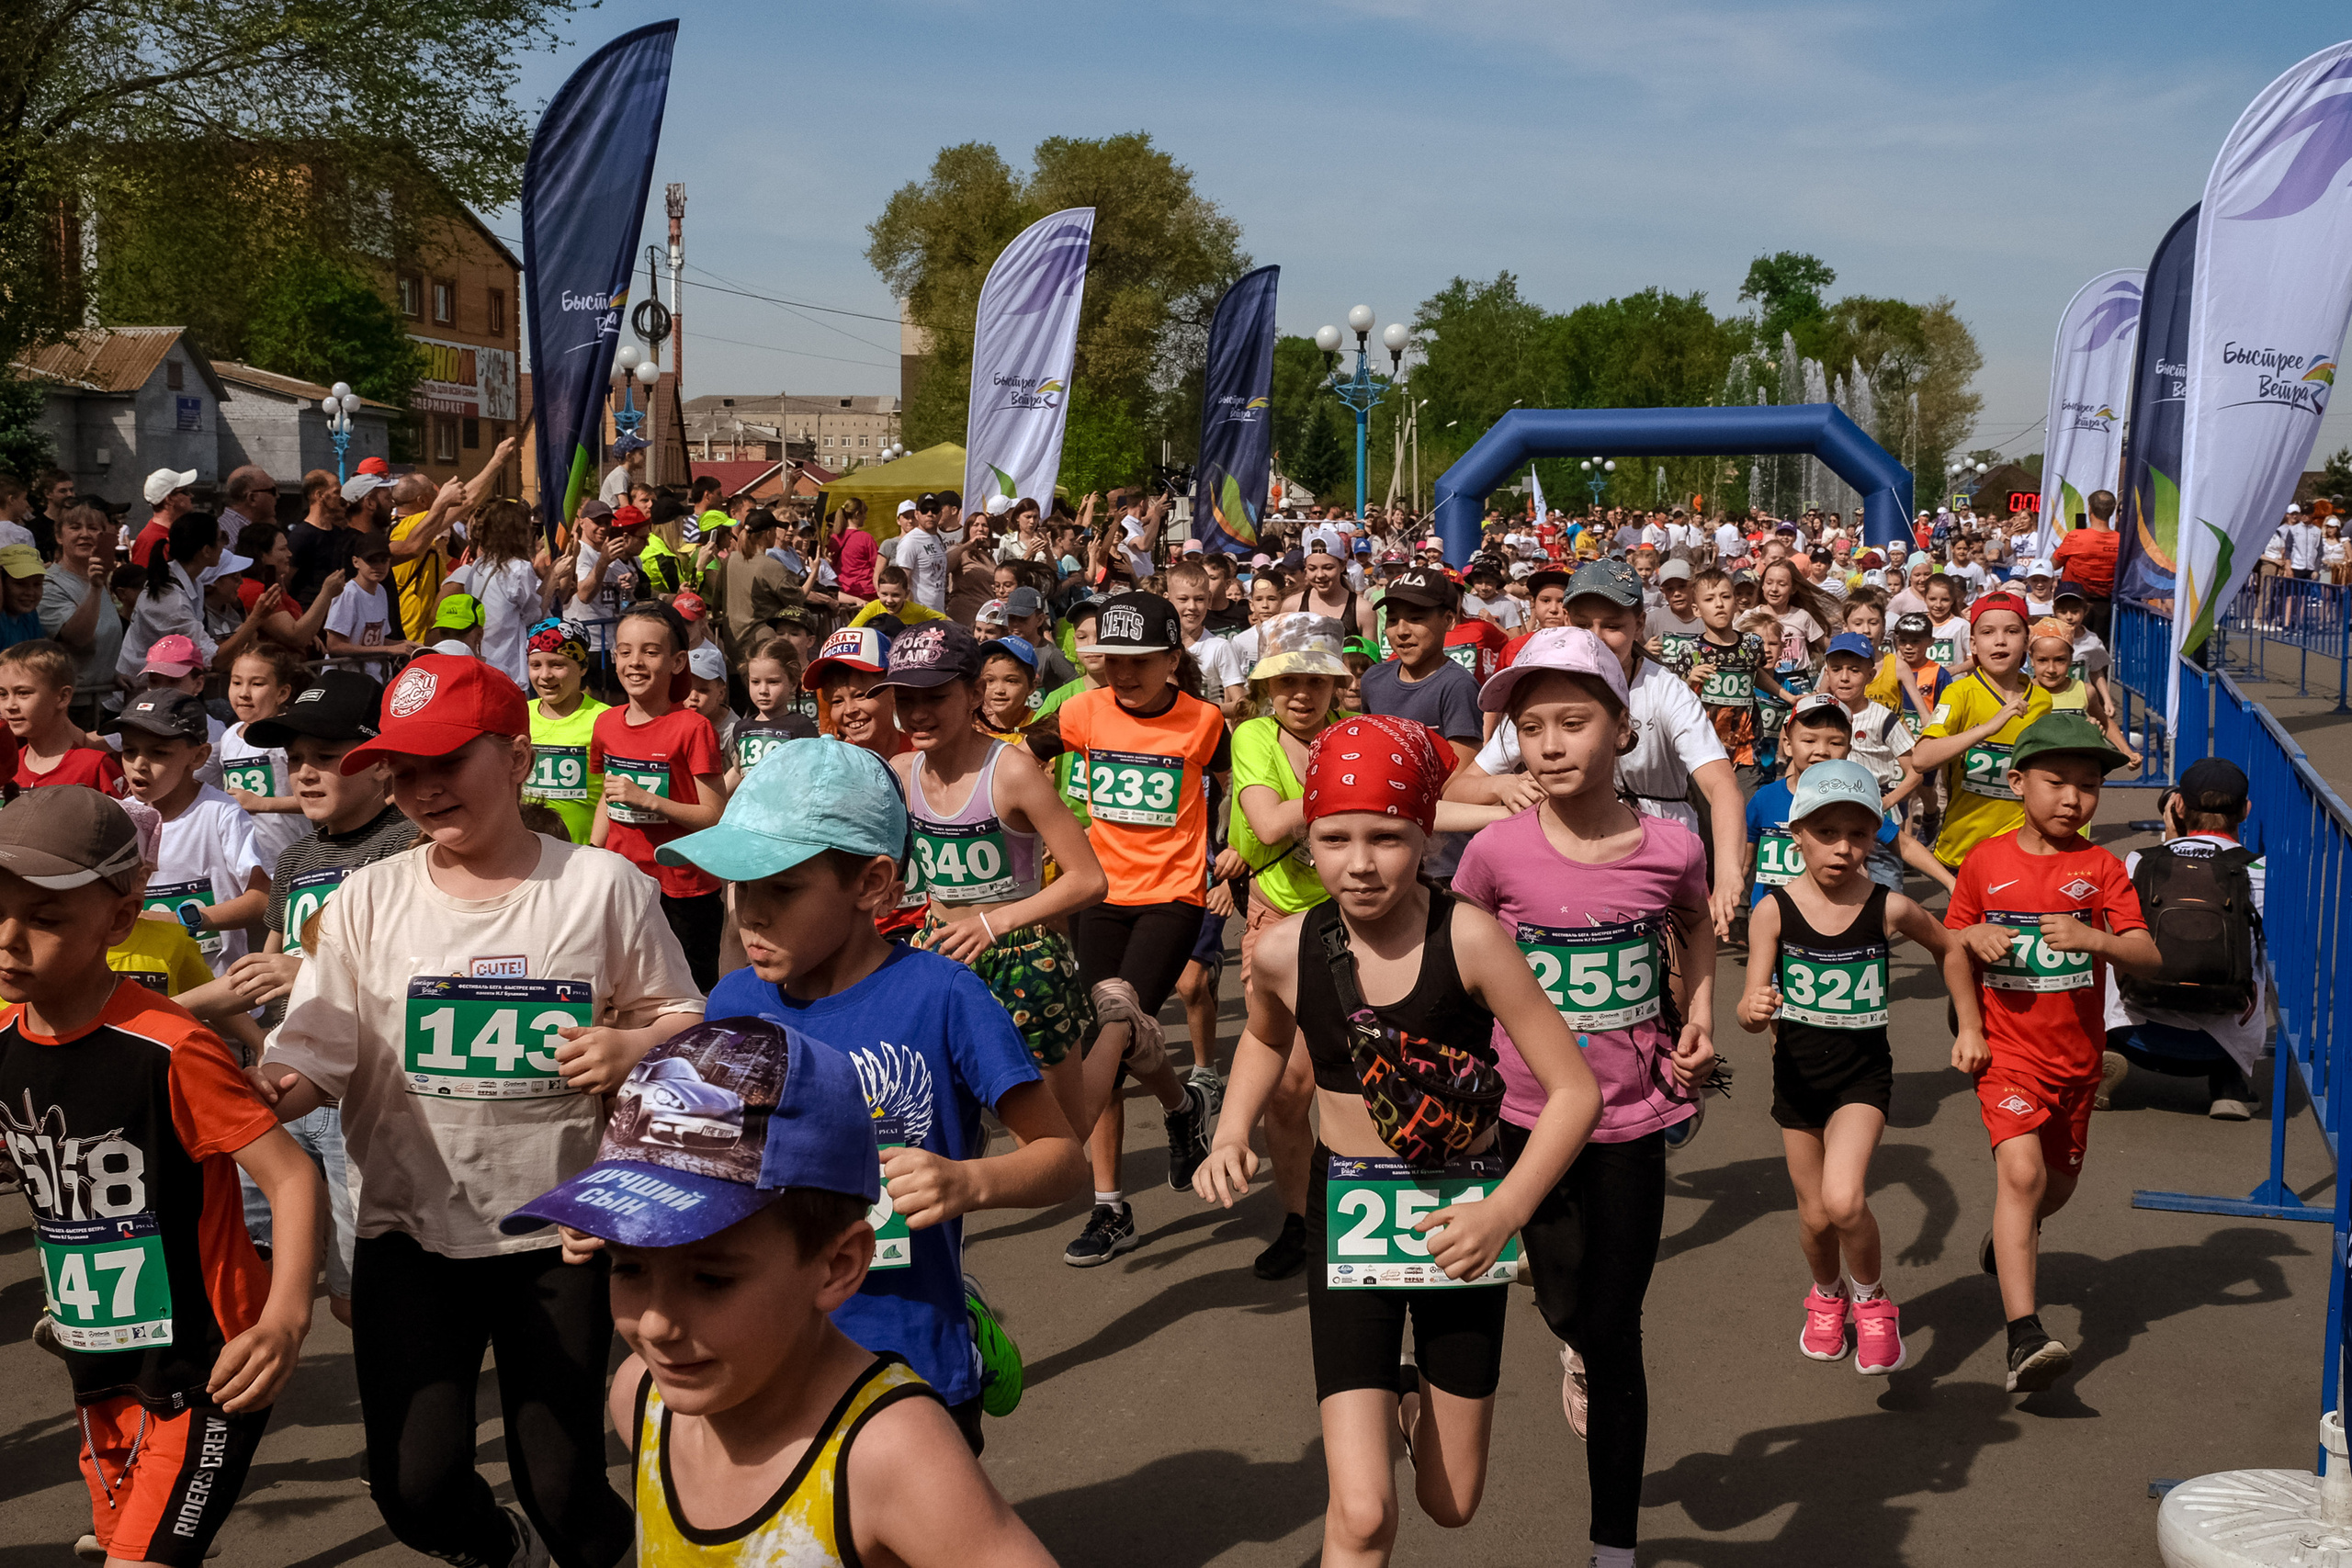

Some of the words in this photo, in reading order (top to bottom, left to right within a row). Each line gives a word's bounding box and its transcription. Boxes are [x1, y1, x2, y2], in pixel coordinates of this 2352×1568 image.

[2224, 342, 2304, 373] Быстрее
[993, 372, 1036, 393] Быстрее
[2258, 375, 2310, 408] Ветра
[1011, 391, 1042, 411] Ветра
[2061, 398, 2095, 418] Быстрее
[1389, 572, 1426, 588] FILA
[1110, 604, 1137, 613] BROOKLYN
[1101, 610, 1144, 641] NETS
[889, 649, 931, 666] GLAM
[1704, 673, 1752, 696] 303
[1092, 766, 1174, 808] 233
[916, 837, 1001, 883] 340
[477, 962, 522, 976] CUTE!
[1526, 942, 1653, 1007] 255
[1787, 964, 1883, 1010] 324
[417, 1008, 579, 1072] 143
[705, 1126, 718, 1136] THE
[575, 1188, 650, 1215] СЫН
[576, 1168, 706, 1212] ЛУЧШИЙ
[1337, 1187, 1485, 1256] 25
[199, 1416, 228, 1469] CREW
[173, 1469, 215, 1539] RIDERS
